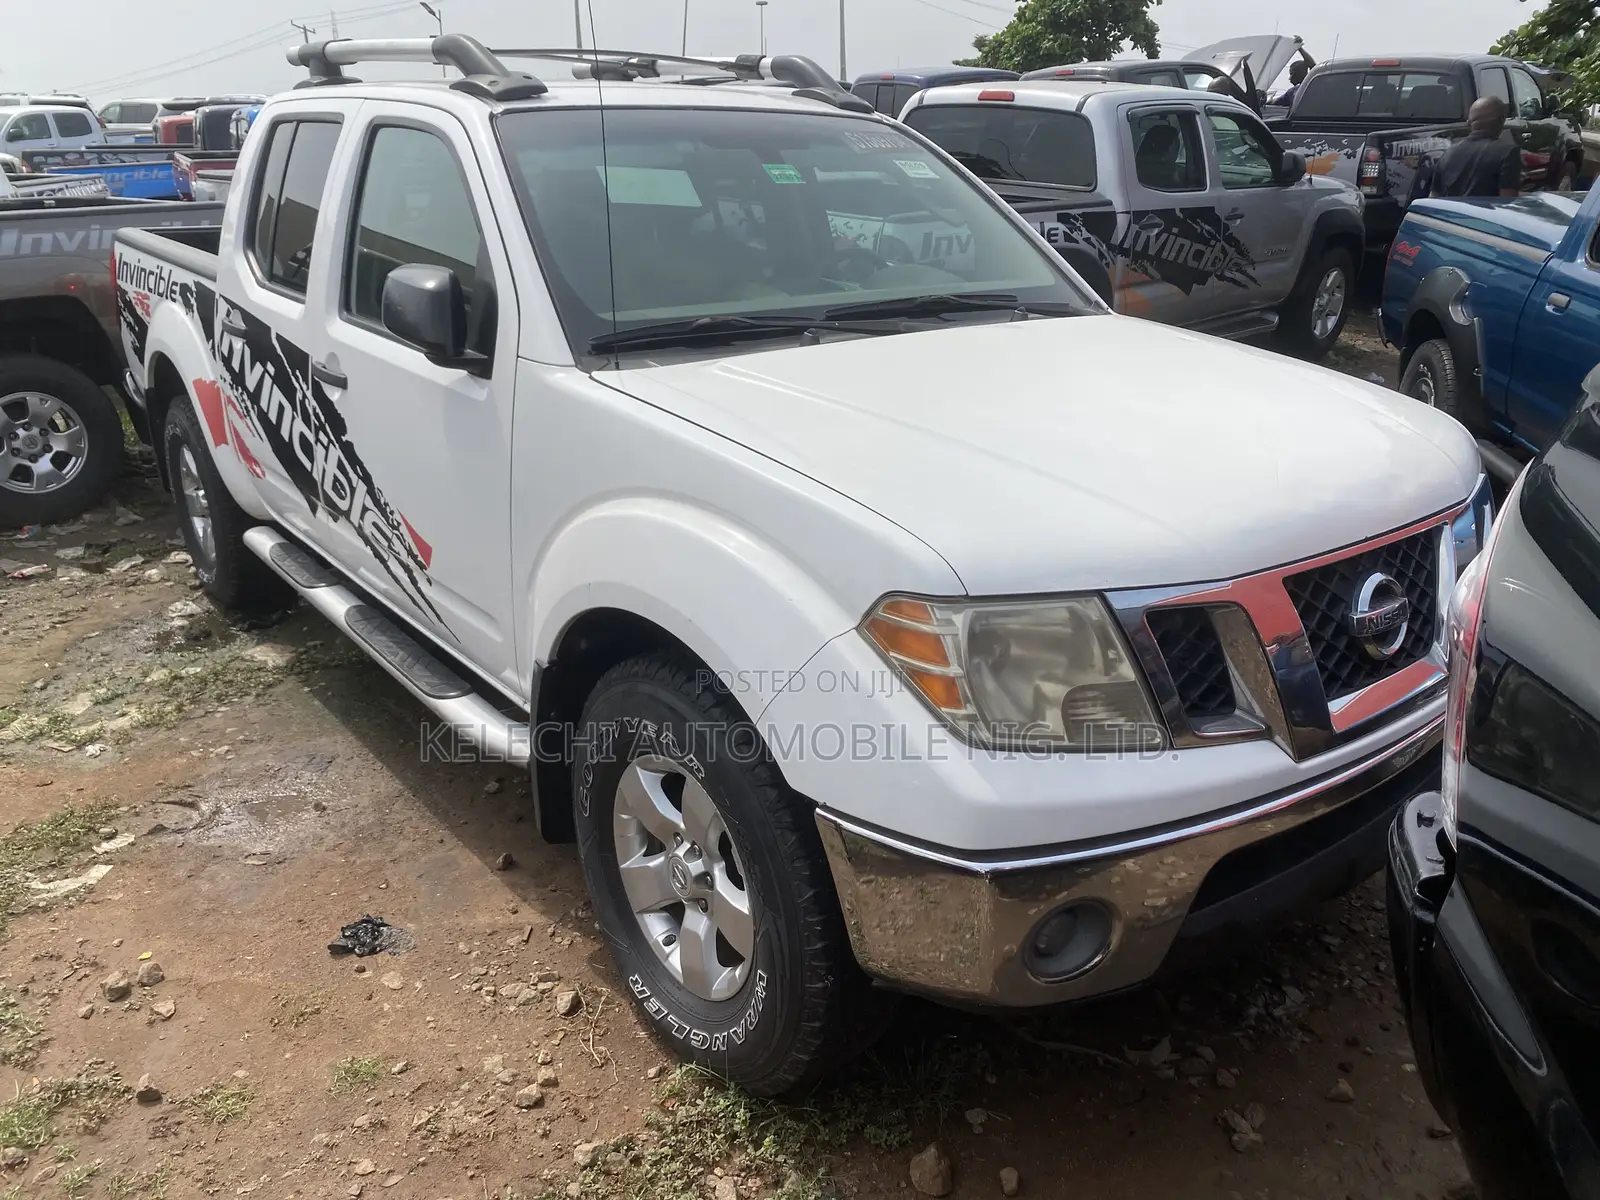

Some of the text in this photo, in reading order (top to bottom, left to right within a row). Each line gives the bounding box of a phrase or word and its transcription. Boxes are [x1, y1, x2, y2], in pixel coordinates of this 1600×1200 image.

[117, 252, 179, 301] Invincible
[1109, 225, 1249, 276] Invincible
[215, 297, 400, 561] Invincible
[578, 717, 706, 817] GOODYEAR
[628, 969, 767, 1051] WRANGLER
